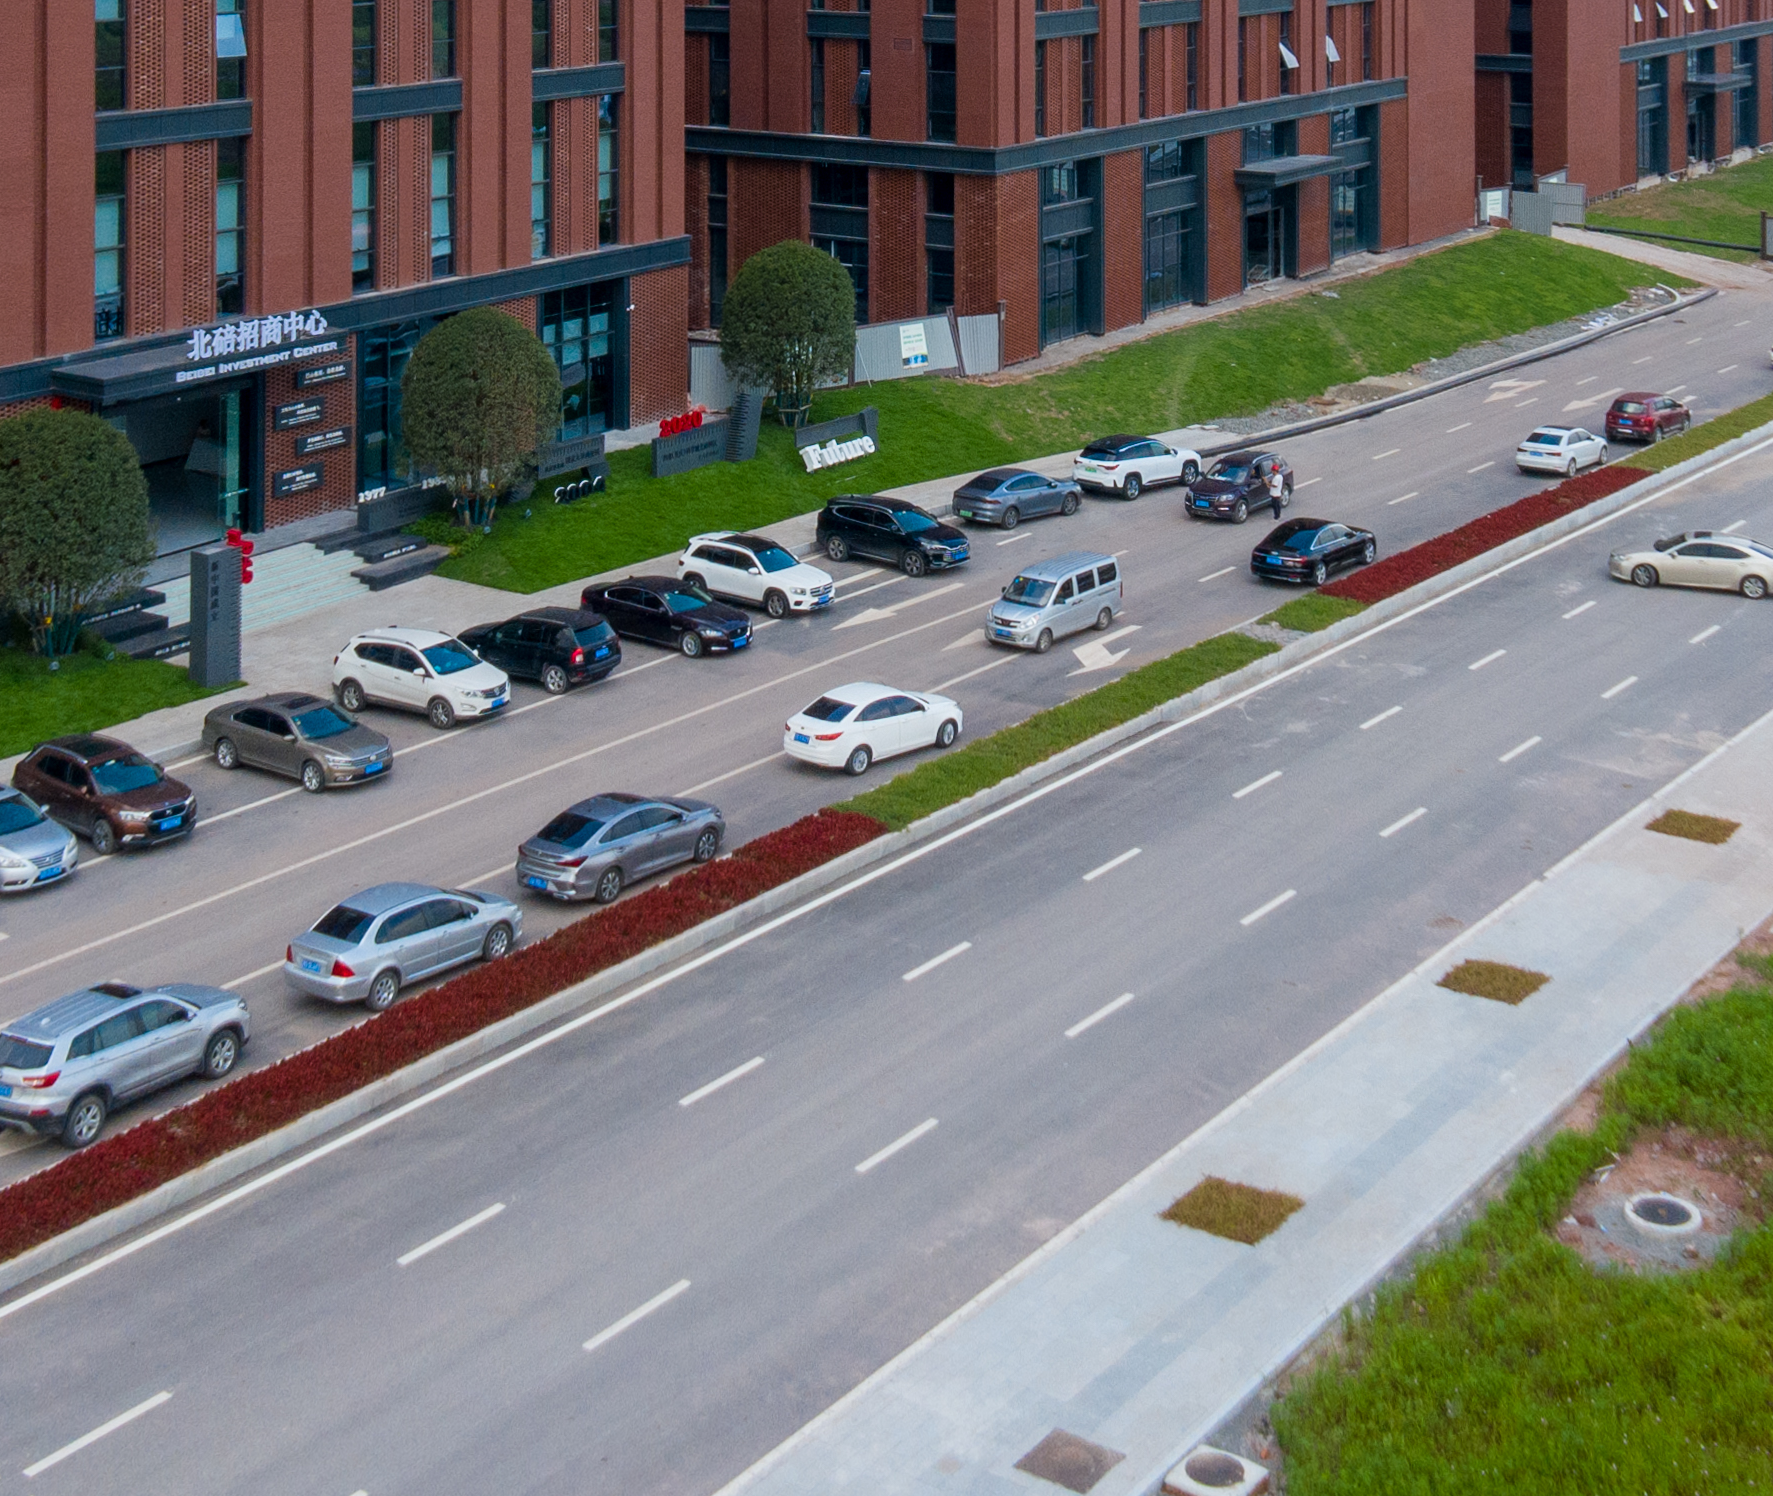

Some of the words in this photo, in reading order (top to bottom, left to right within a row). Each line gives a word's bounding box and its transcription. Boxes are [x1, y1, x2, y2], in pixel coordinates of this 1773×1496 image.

[186, 310, 328, 362] 北碚招商中心
[218, 351, 291, 374] INVESTMENT
[293, 341, 338, 359] CENTER
[659, 410, 703, 438] 2020
[799, 435, 876, 473] Future
[358, 486, 387, 503] 1977
